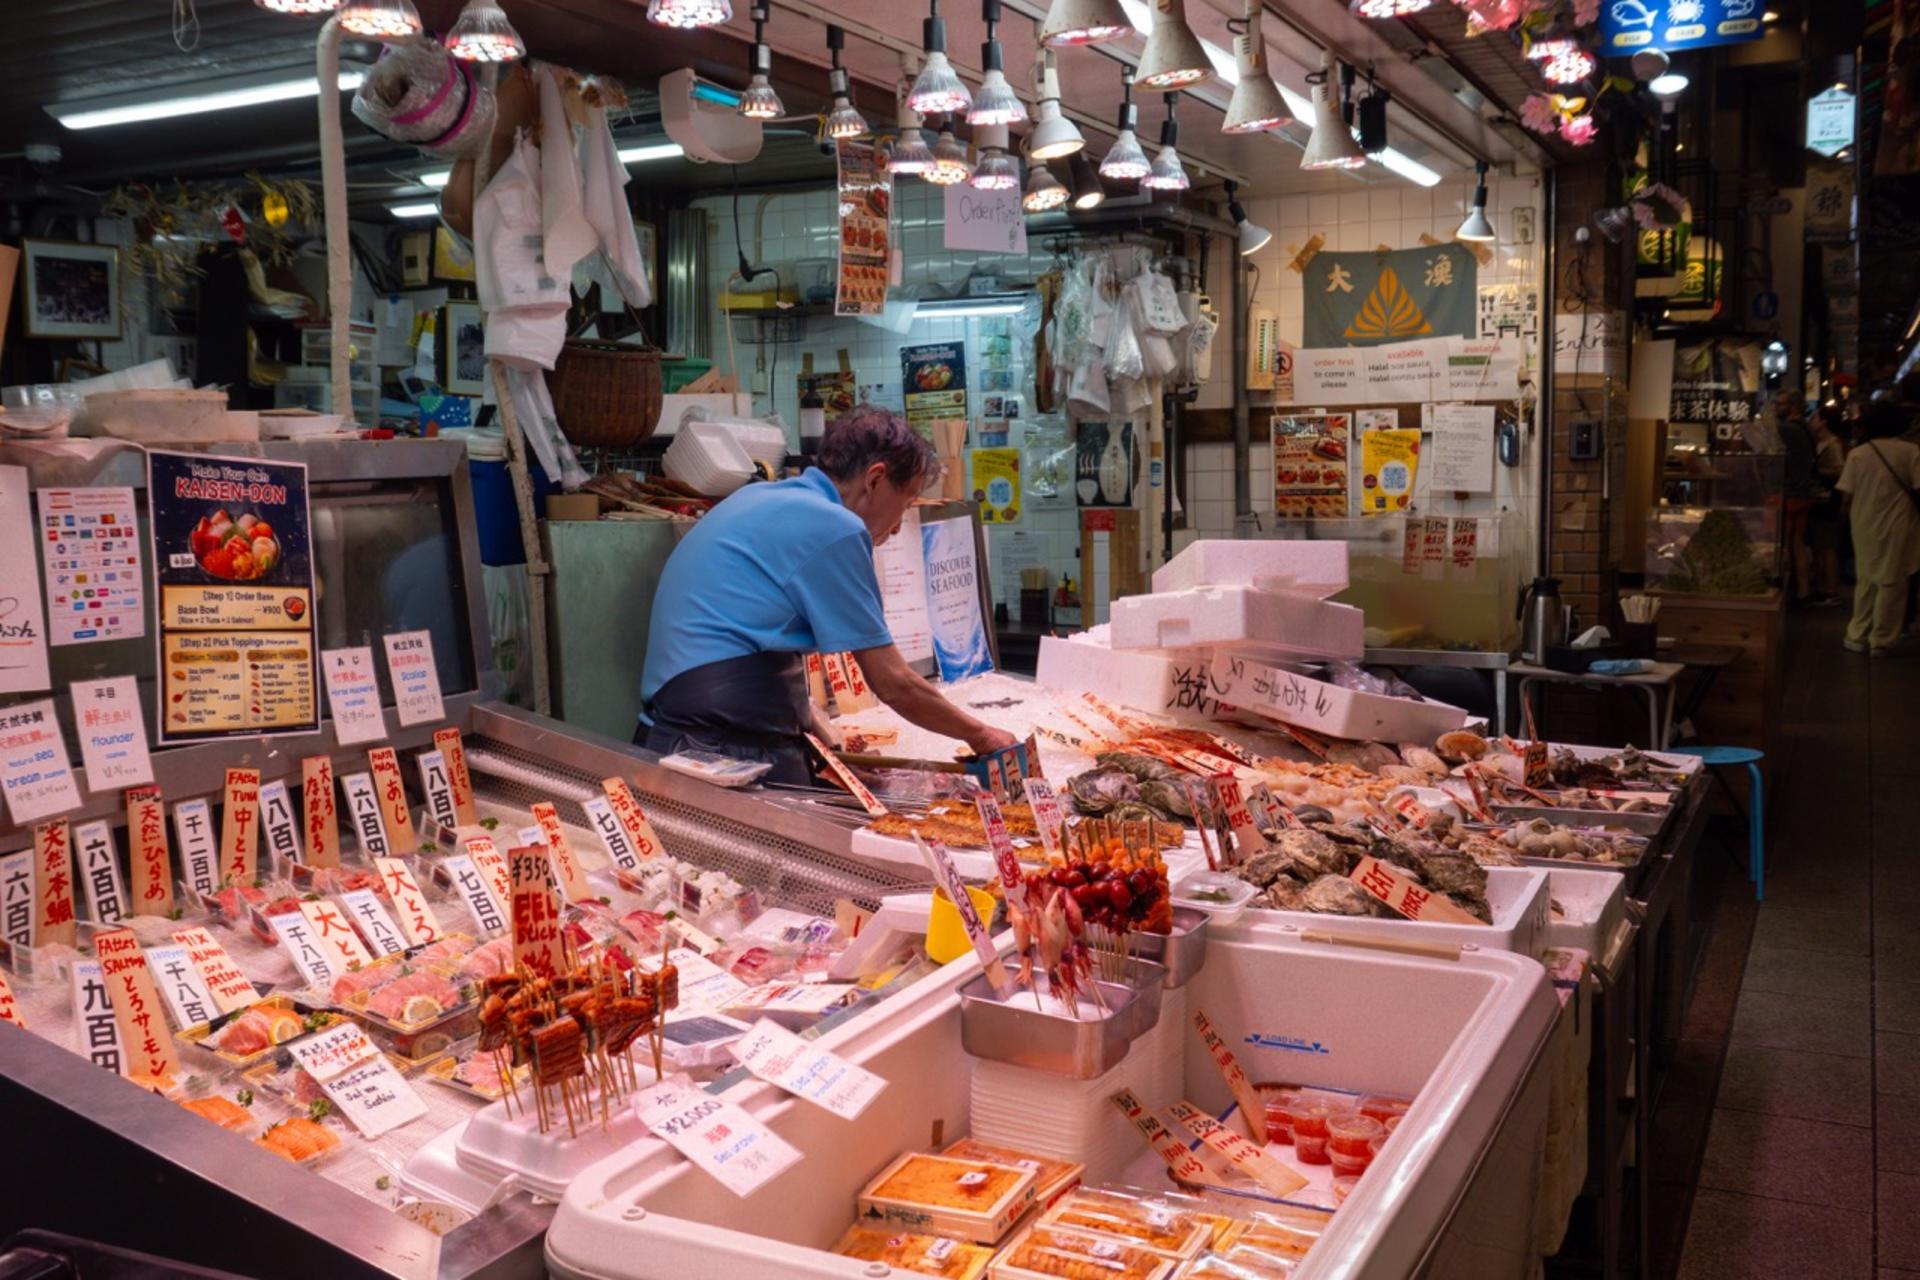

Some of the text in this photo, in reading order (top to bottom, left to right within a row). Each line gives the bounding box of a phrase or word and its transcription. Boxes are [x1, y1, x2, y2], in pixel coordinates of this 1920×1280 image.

[959, 195, 994, 224] Order
[1368, 363, 1389, 372] Halal
[1369, 374, 1390, 383] Halal
[1321, 381, 1348, 389] please
[175, 476, 287, 504] KAISEN-DON
[930, 555, 972, 578] DISCOVER
[235, 591, 256, 600] Order
[257, 592, 275, 601] Base
[930, 572, 974, 595] SEAFOOD
[178, 605, 198, 614] Base
[200, 605, 220, 614] Bowl
[213, 637, 230, 647] Pick
[231, 637, 265, 649] Toppings
[91, 731, 135, 748] flounder
[6, 771, 42, 789] bream
[231, 790, 257, 803] TUNA
[386, 779, 408, 825] あじ
[1219, 782, 1240, 810] EAT
[353, 788, 387, 857] 六百円
[1230, 809, 1254, 828] HERE
[141, 805, 166, 902] 天然ひらめ
[186, 814, 213, 896] 千二百円
[230, 807, 253, 877] 中とろ
[596, 812, 637, 869] 七百円
[477, 854, 503, 867] TUNA
[511, 854, 550, 888] ¥350
[43, 826, 74, 928] 天然本鯛
[85, 838, 122, 923] 六百円
[1360, 862, 1395, 901] EAT
[387, 863, 435, 943] 大とろ
[458, 870, 503, 932] 七百円
[513, 891, 559, 925] EEL
[1399, 885, 1431, 921] HERE
[175, 933, 209, 946] MIX
[103, 955, 147, 976] SALMON
[164, 961, 209, 1024] 千八百
[219, 982, 252, 998] TUNA
[82, 979, 122, 1075] 九百円
[122, 974, 168, 1077] とろサーモン
[657, 1099, 723, 1136] ¥2,000
